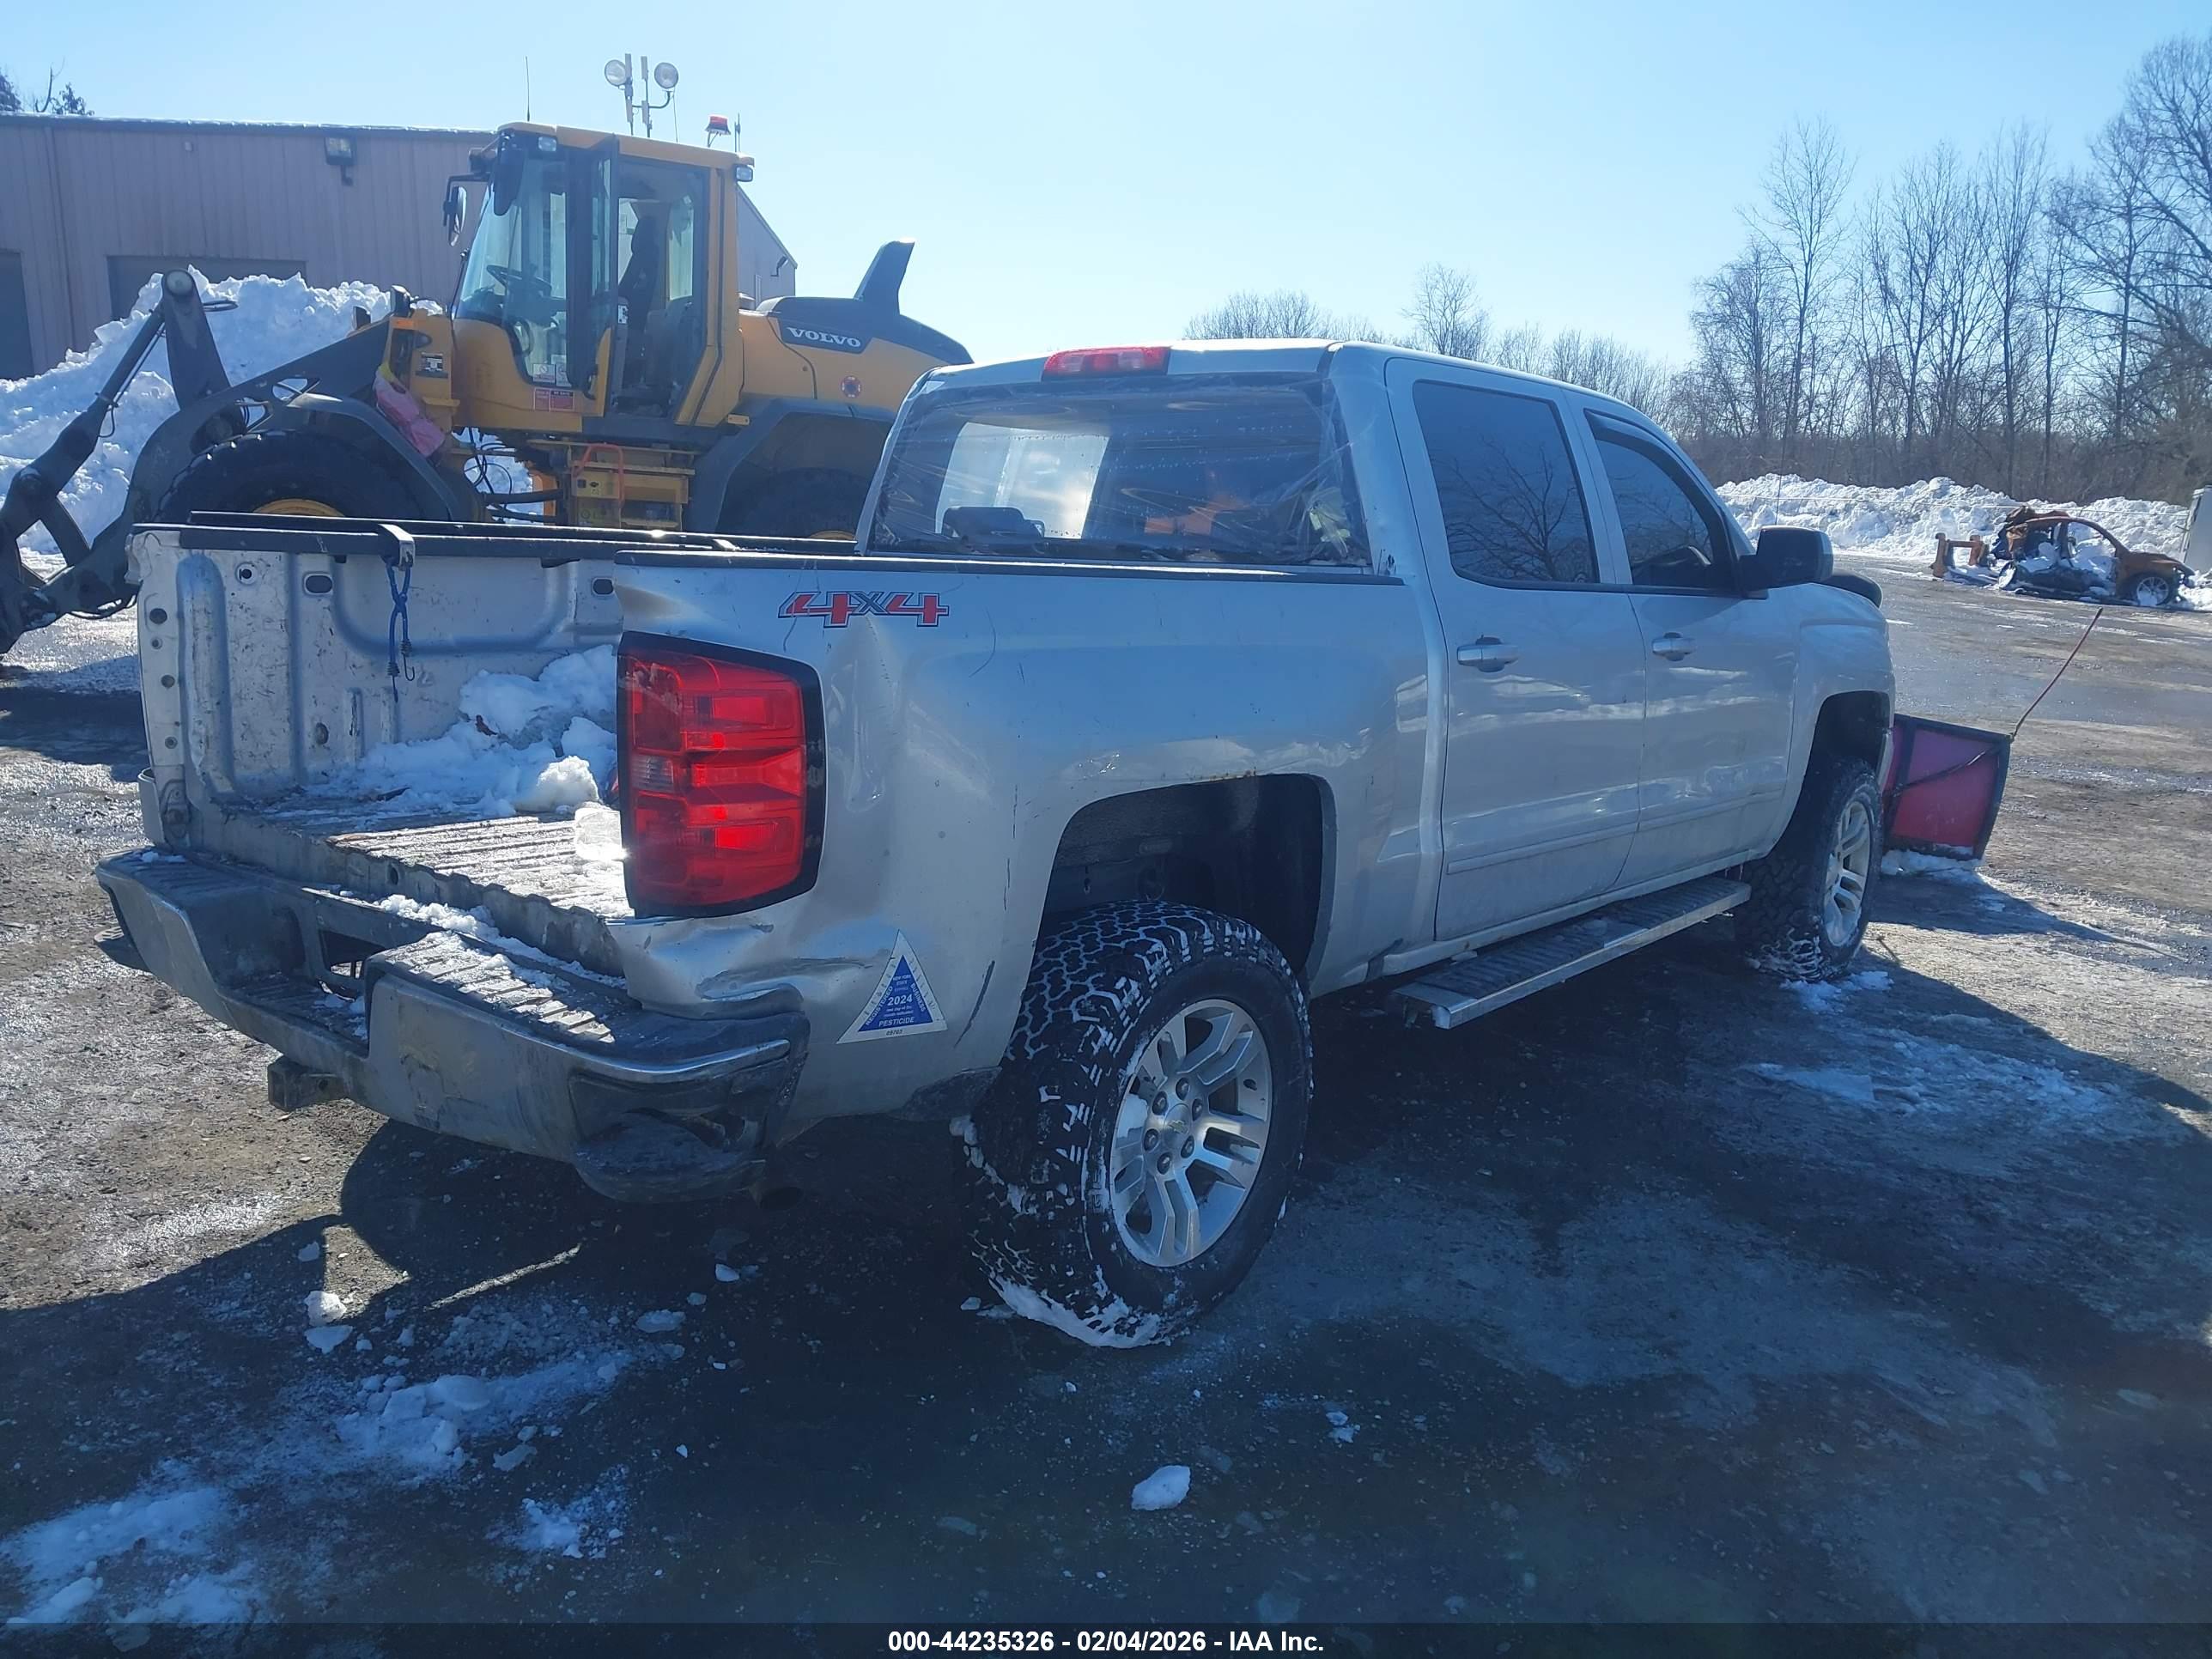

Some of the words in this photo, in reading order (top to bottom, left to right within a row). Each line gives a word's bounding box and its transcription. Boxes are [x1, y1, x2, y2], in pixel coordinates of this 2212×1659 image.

[787, 327, 861, 348] VOLVO
[866, 986, 893, 1025] REGISTERED
[888, 994, 913, 1006] 2024
[910, 982, 927, 1012] BUSINESS
[878, 1016, 915, 1027] PESTICIDE
